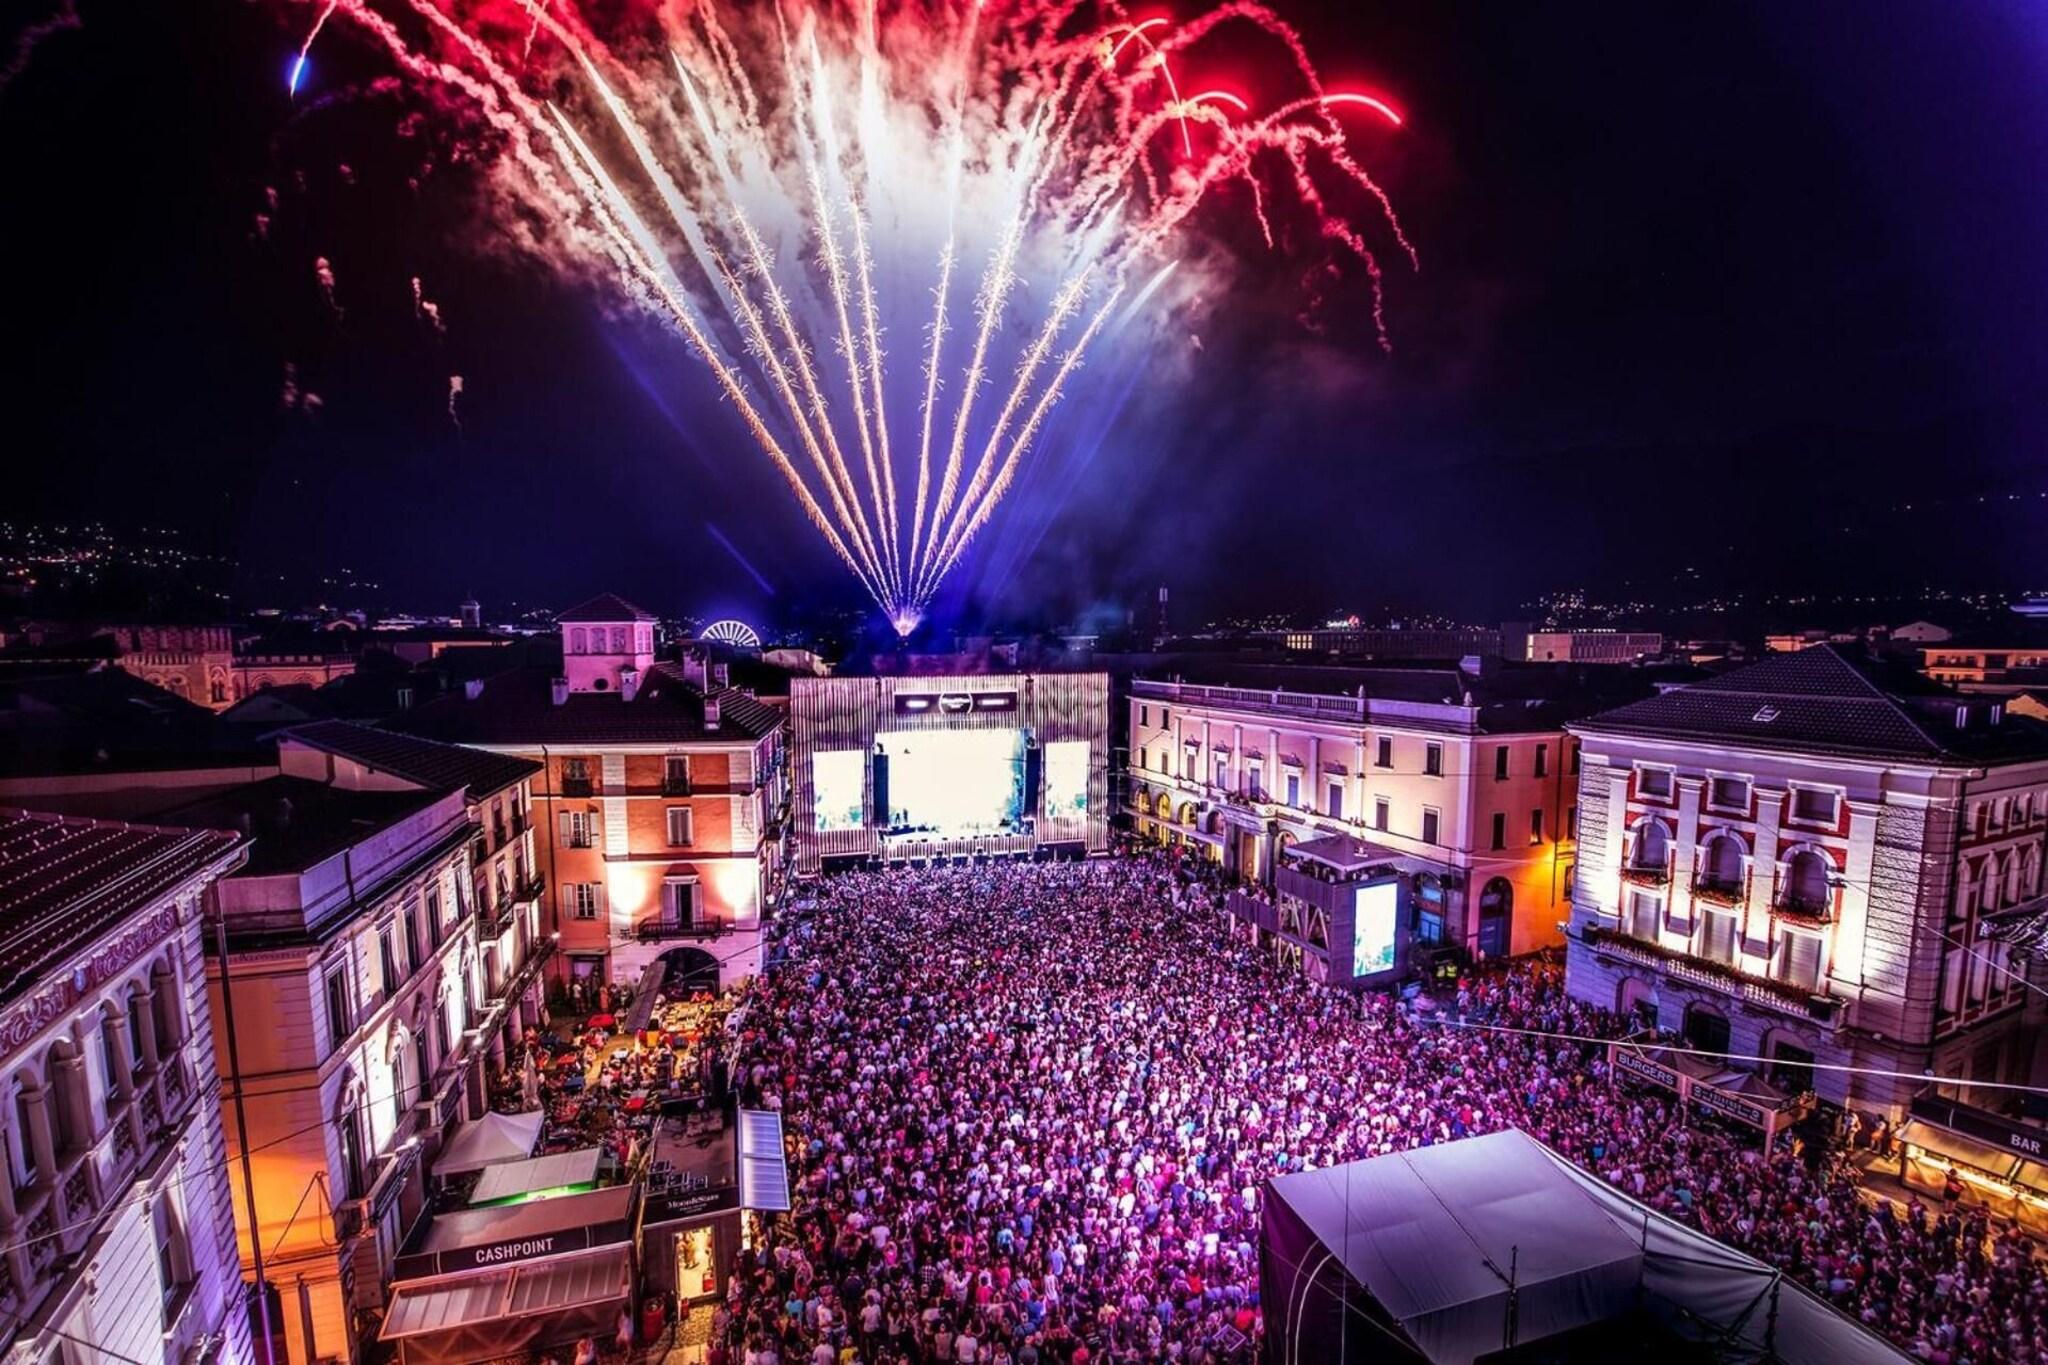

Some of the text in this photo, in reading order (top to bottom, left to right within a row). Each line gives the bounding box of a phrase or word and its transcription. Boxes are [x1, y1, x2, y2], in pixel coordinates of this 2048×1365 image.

[1619, 1053, 1674, 1085] BURGERS
[2011, 1134, 2040, 1154] BAR
[475, 1238, 554, 1263] CASHPOINT
